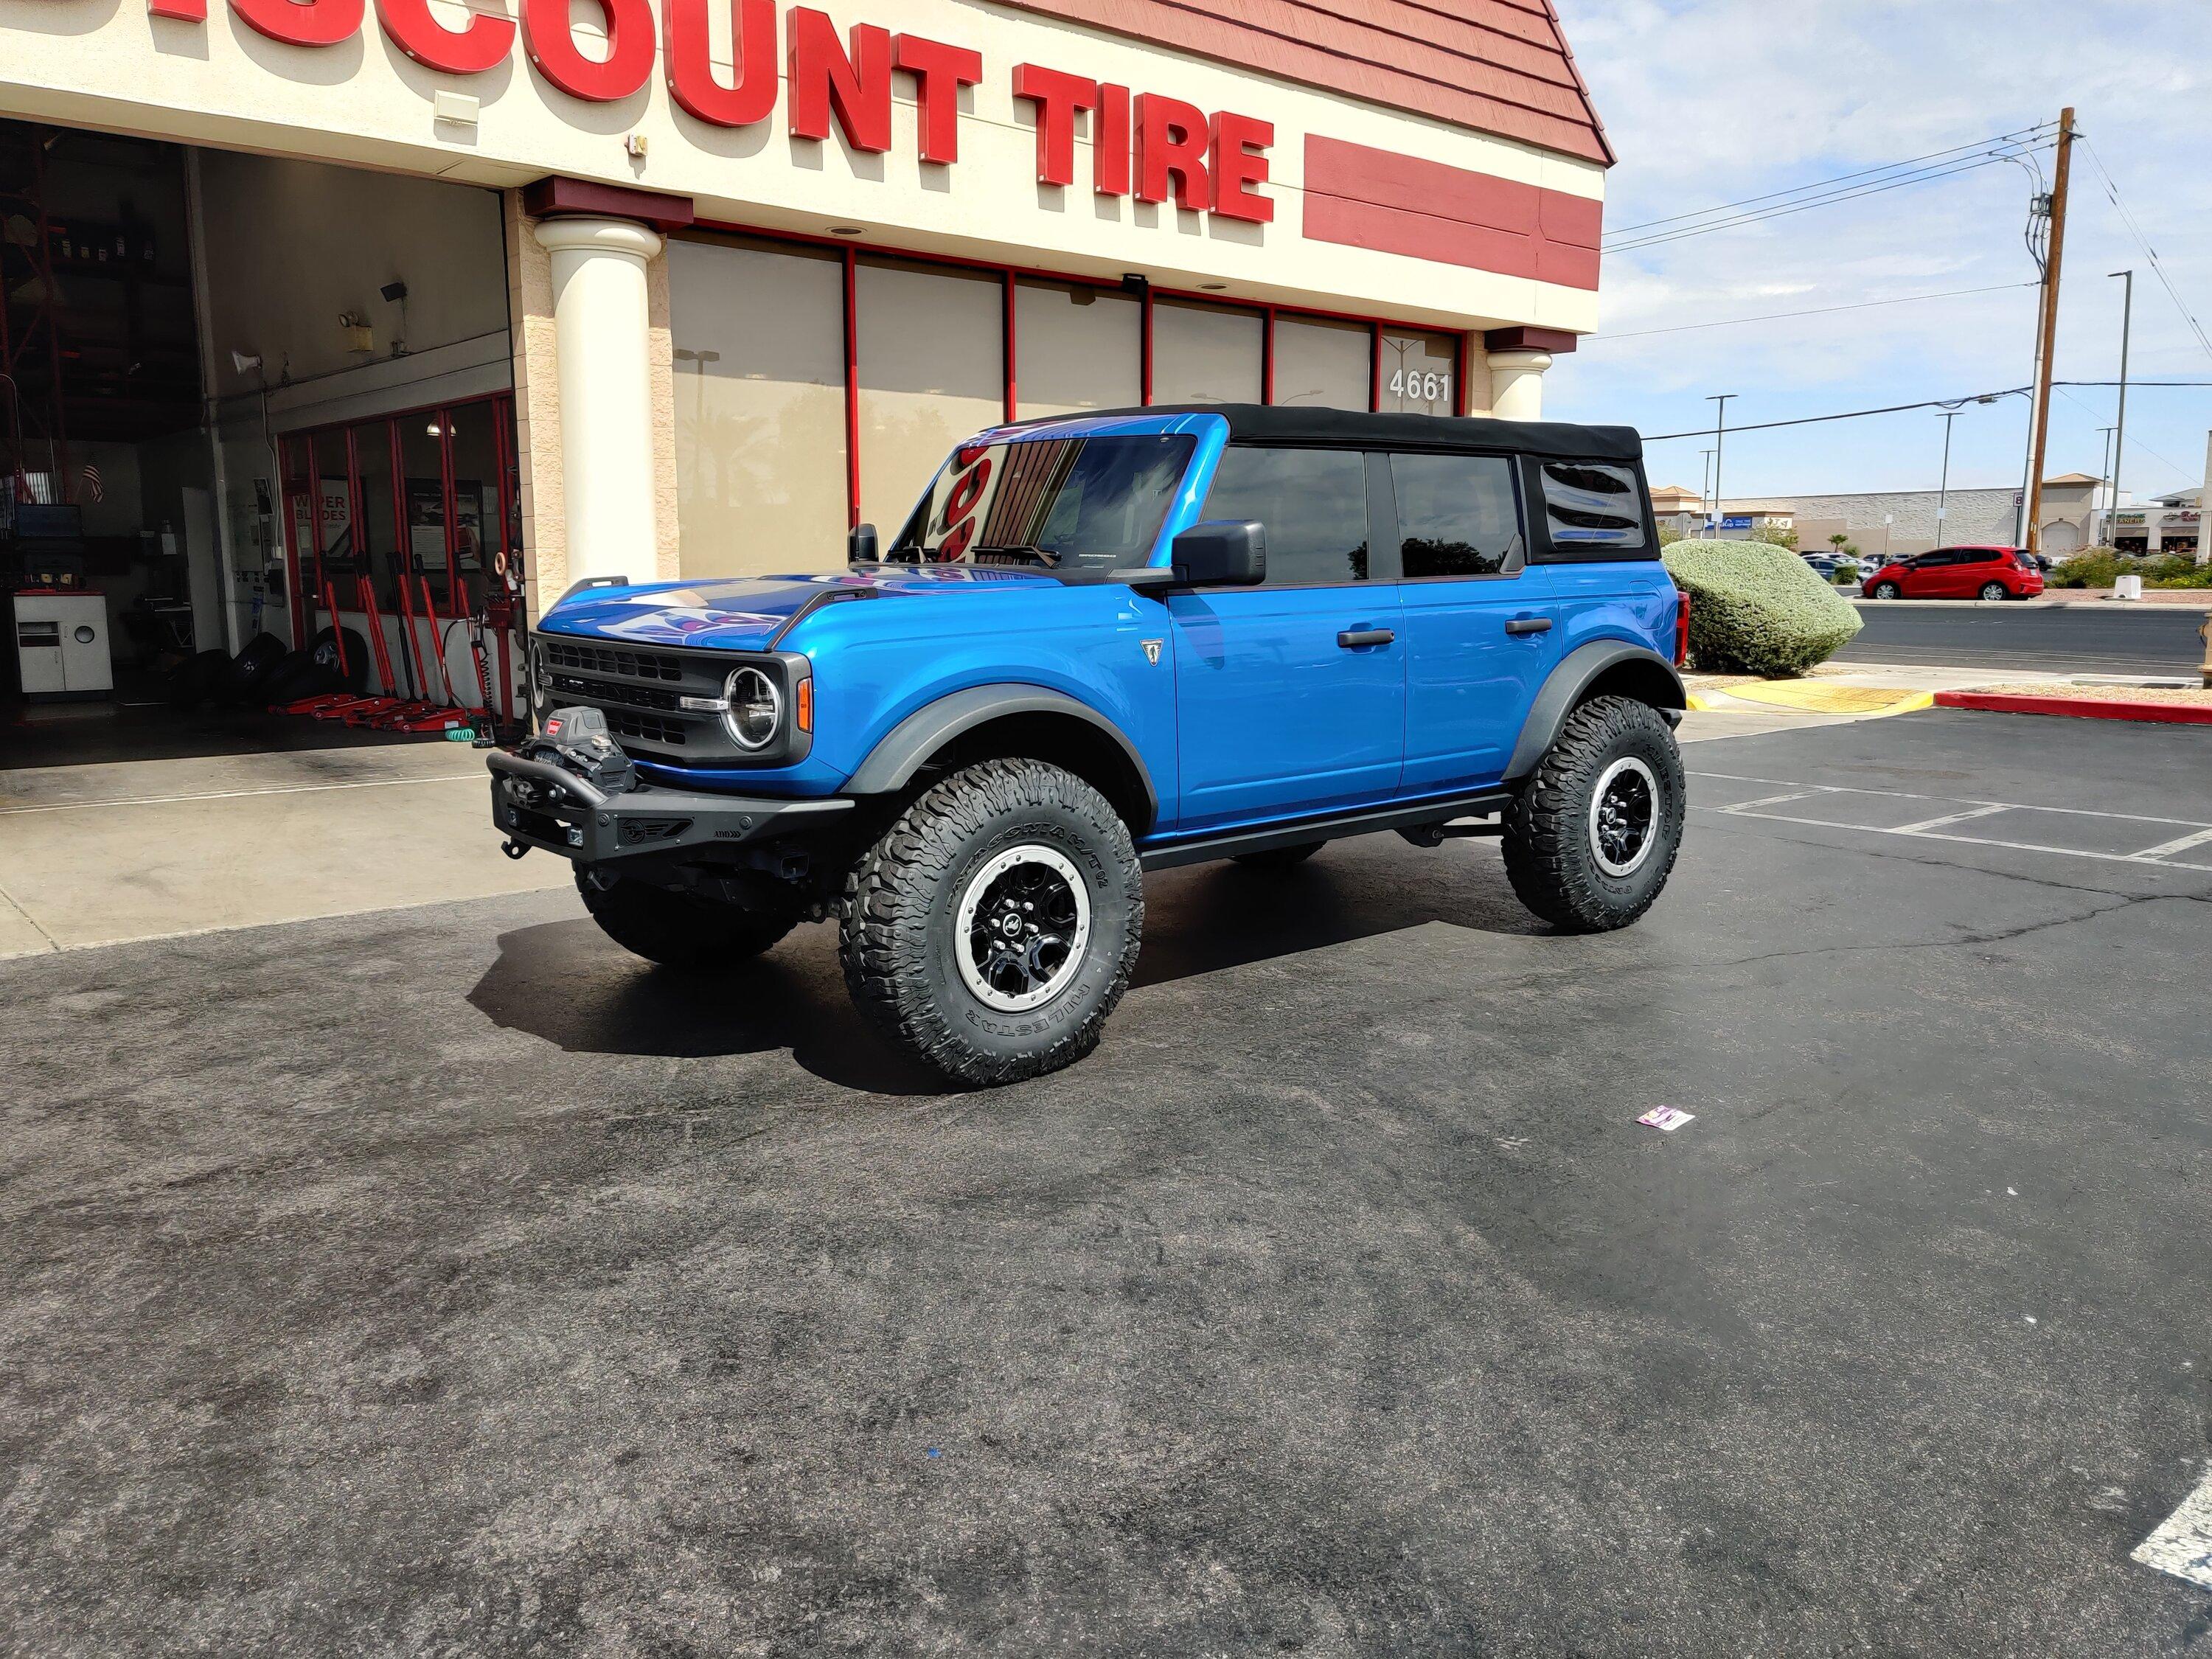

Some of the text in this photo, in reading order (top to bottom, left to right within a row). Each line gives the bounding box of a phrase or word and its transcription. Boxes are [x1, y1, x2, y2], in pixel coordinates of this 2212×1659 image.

[1012, 62, 1275, 225] TIRE
[1389, 369, 1450, 403] 4661
[295, 495, 345, 509] WER
[296, 509, 346, 521] BLDES
[945, 822, 1065, 916] PATAGONIA
[964, 983, 1091, 1037] MILESTAR
